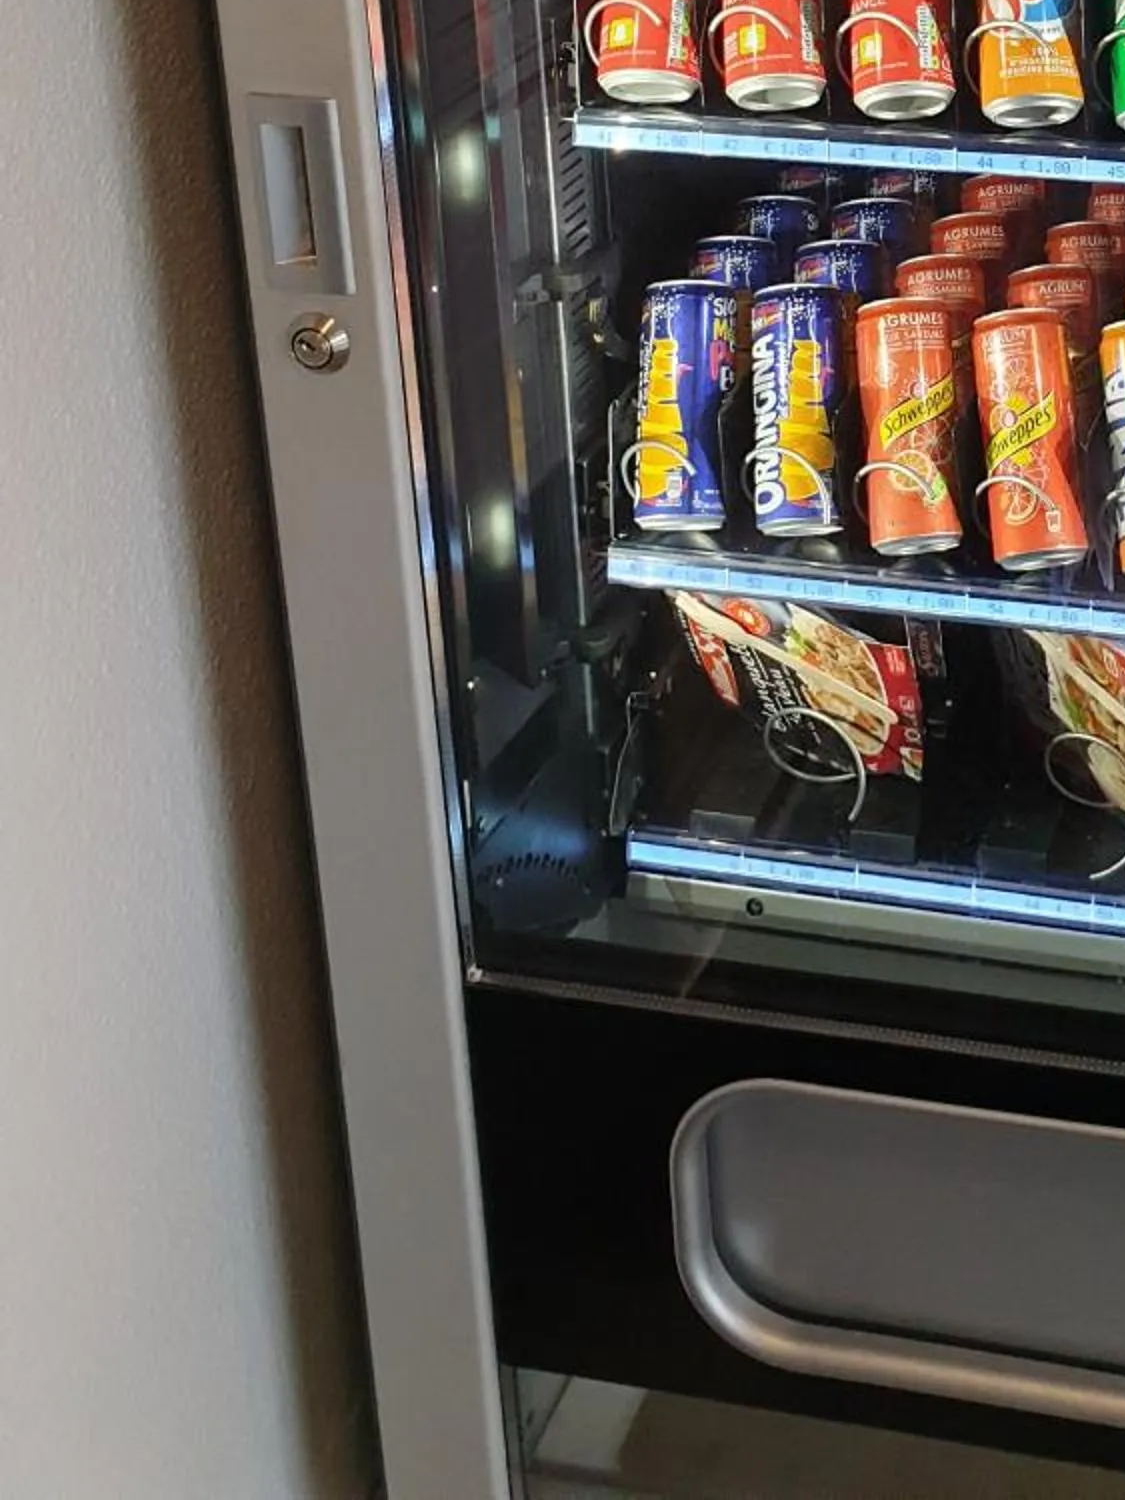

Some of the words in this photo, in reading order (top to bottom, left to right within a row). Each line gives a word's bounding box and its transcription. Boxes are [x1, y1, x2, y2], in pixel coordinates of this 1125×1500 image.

[976, 155, 994, 169] 44
[1106, 164, 1125, 178] 45
[943, 225, 1006, 242] AGRUMES
[907, 268, 972, 285] AGRUMES
[878, 310, 945, 328] AGRUMES
[883, 383, 954, 440] Schweppes
[752, 332, 787, 516] ORANGINA
